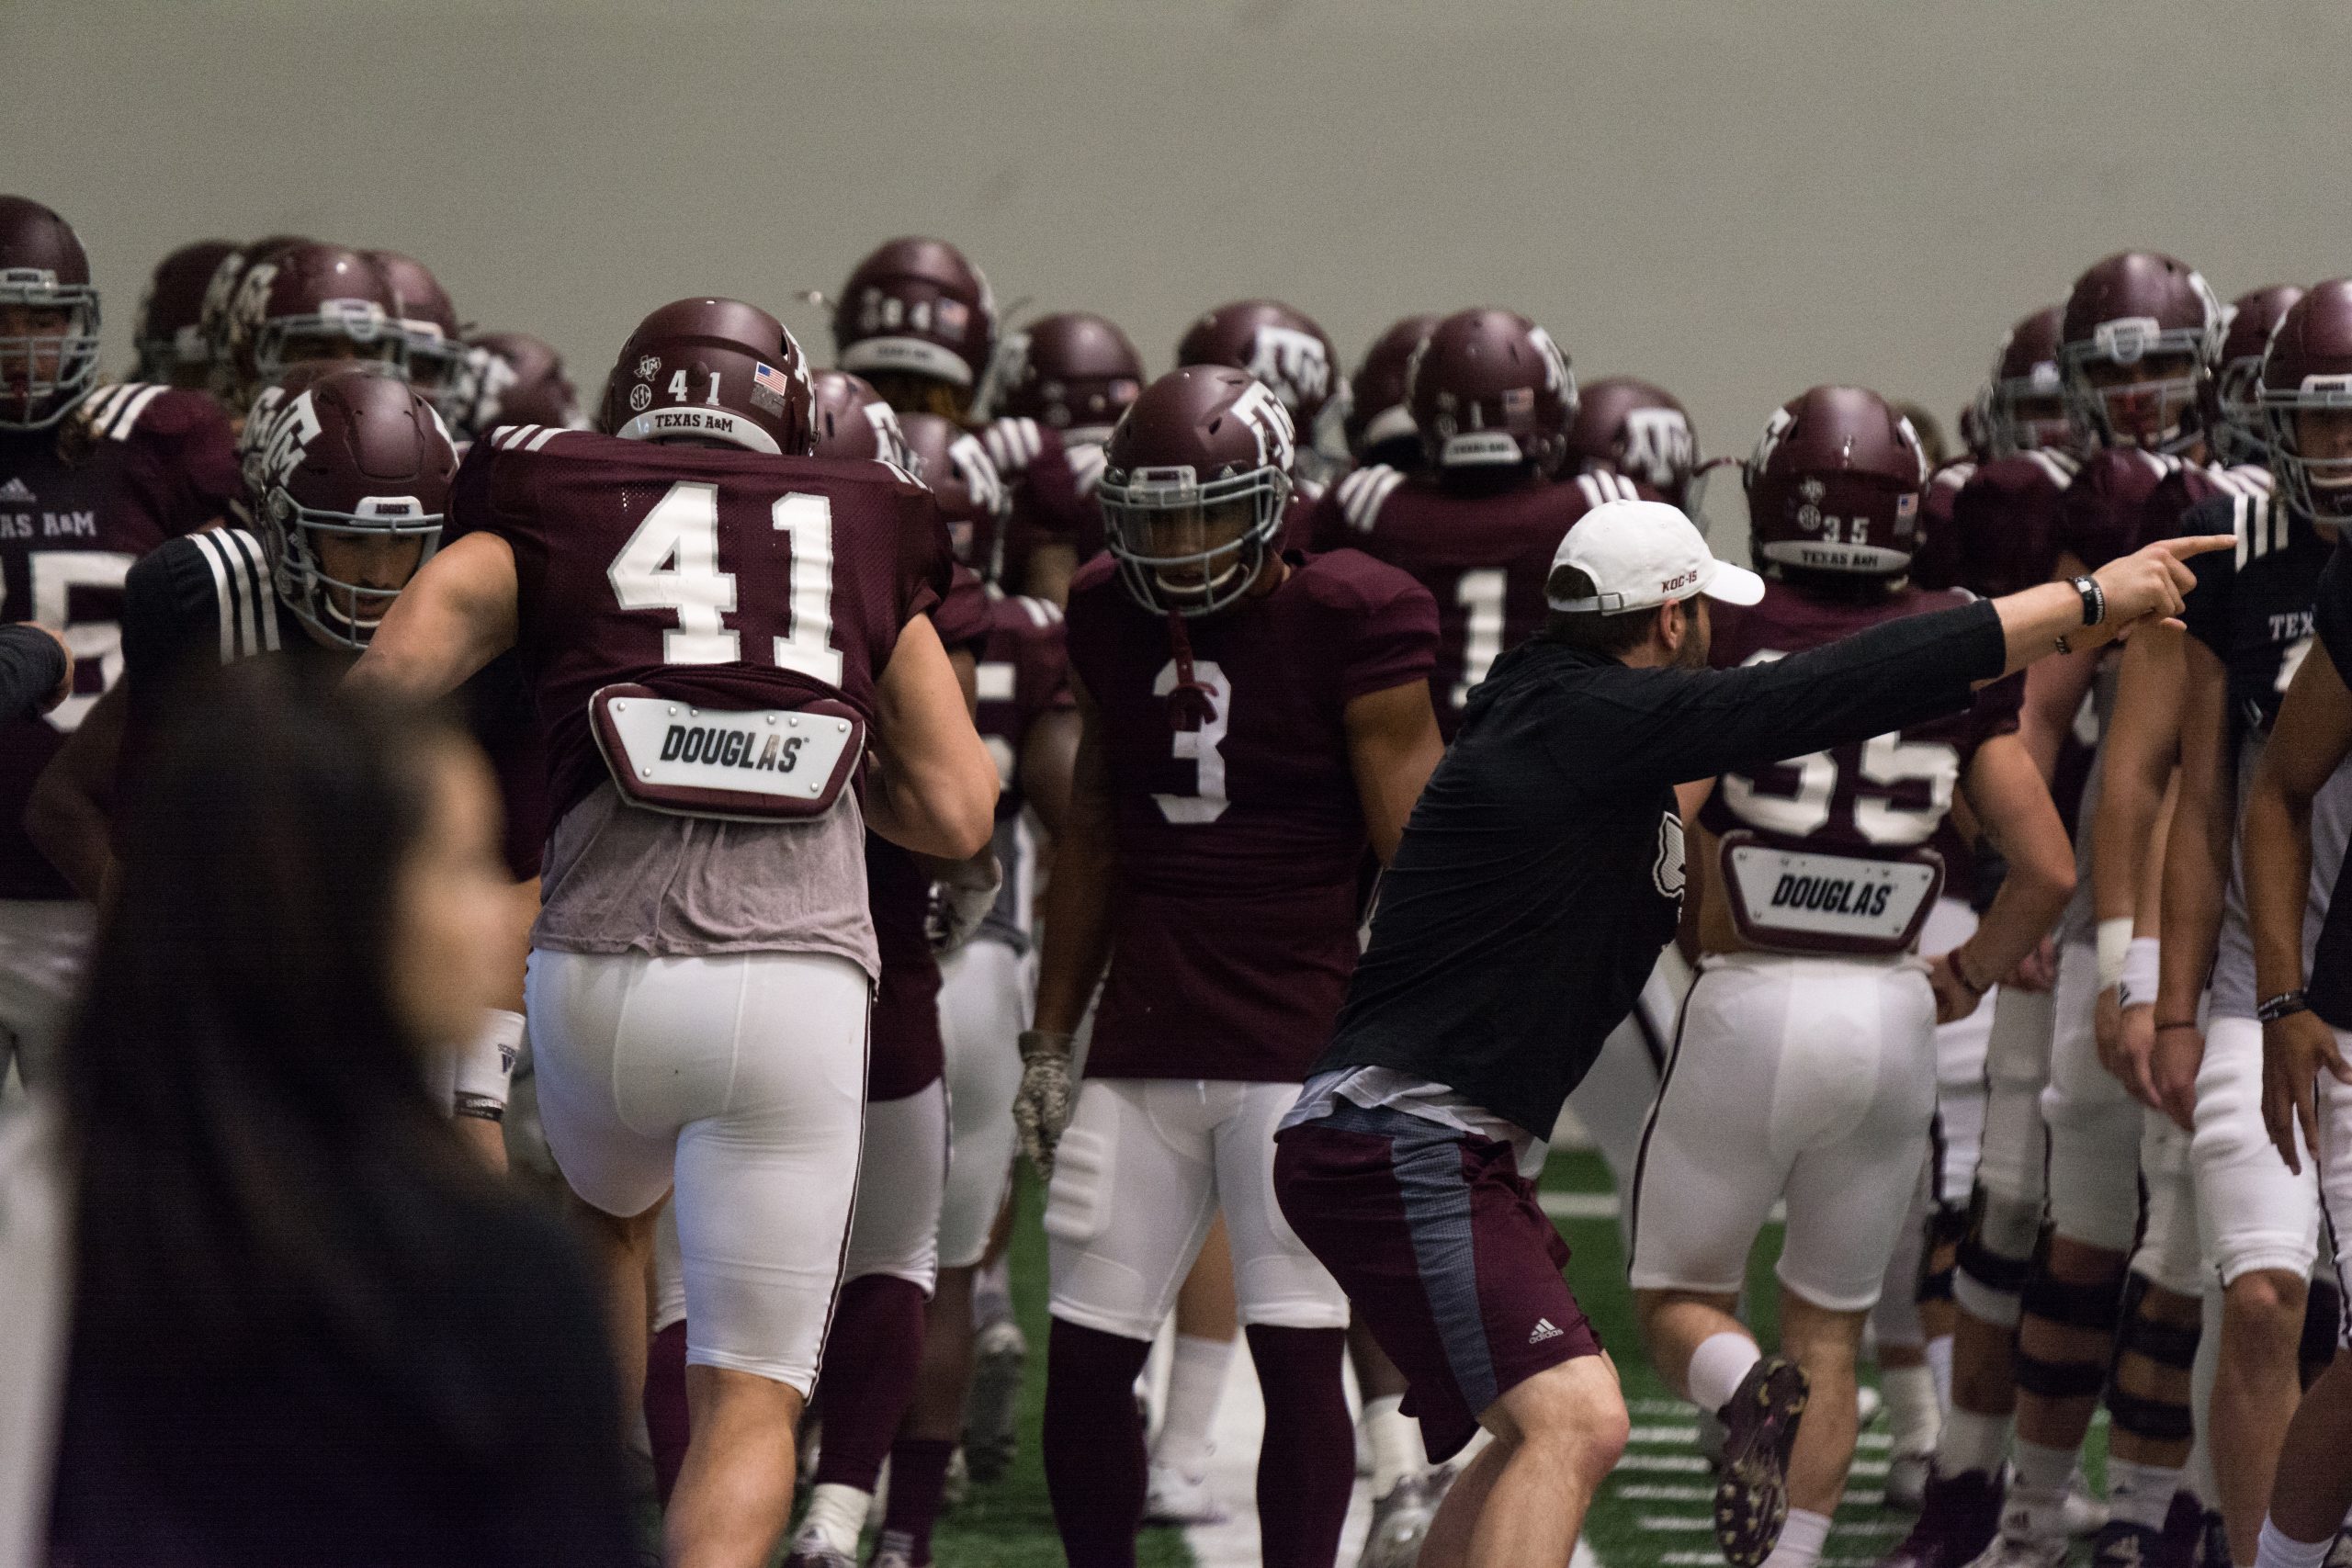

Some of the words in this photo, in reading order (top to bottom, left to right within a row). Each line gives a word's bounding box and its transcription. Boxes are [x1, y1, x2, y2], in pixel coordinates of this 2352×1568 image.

[668, 369, 721, 406] 41
[655, 413, 700, 428] TEXAS
[705, 416, 733, 433] A&M
[1823, 515, 1871, 545] 35
[1802, 549, 1848, 566] TEXAS
[606, 479, 843, 690] 41
[1661, 570, 1698, 593] KOC-15
[0, 550, 137, 734] 5
[660, 725, 802, 773] DOUGLAS
[1150, 659, 1232, 824] 3
[1771, 874, 1893, 918] DOUGLAS
[1529, 1328, 1565, 1344] adidas
